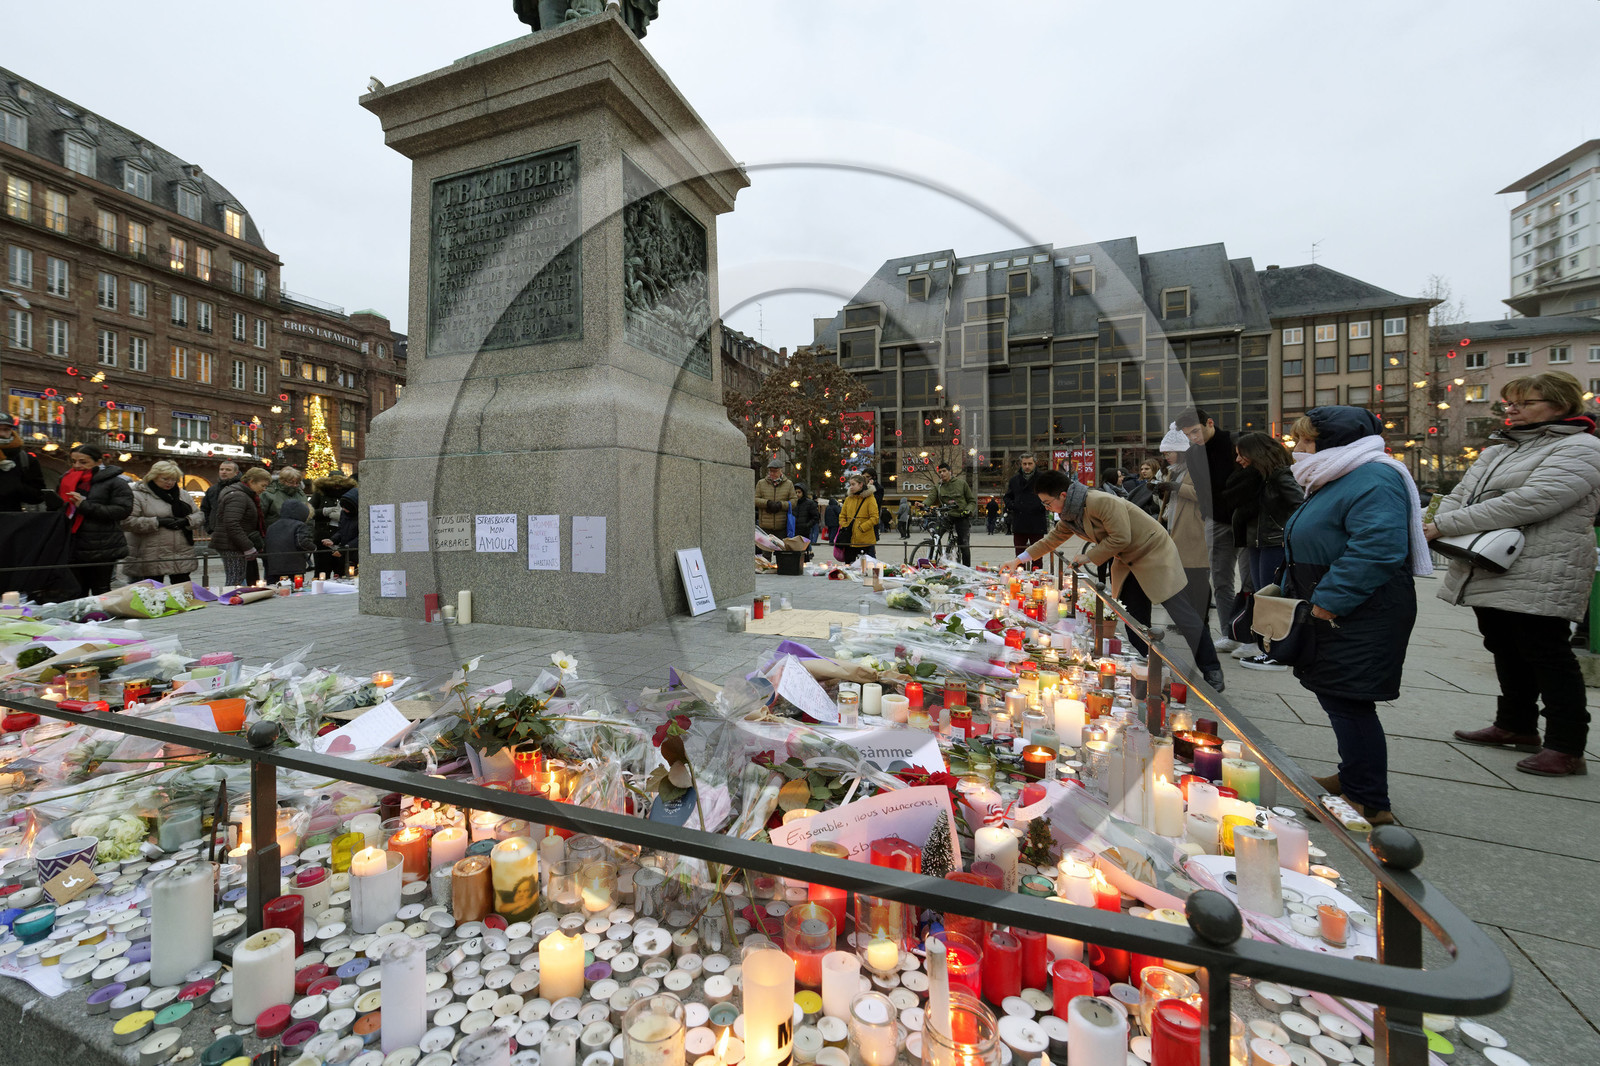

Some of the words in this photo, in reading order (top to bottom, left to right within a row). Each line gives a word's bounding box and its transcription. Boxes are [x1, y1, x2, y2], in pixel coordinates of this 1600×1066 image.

[316, 328, 359, 347] LAFAYETTE
[902, 481, 932, 490] fnac
[436, 516, 454, 525] TOUS
[477, 516, 515, 525] STRASBOURG
[434, 538, 470, 549] BARBARIE
[479, 536, 516, 551] AMOUR
[856, 746, 913, 758] sàmme
